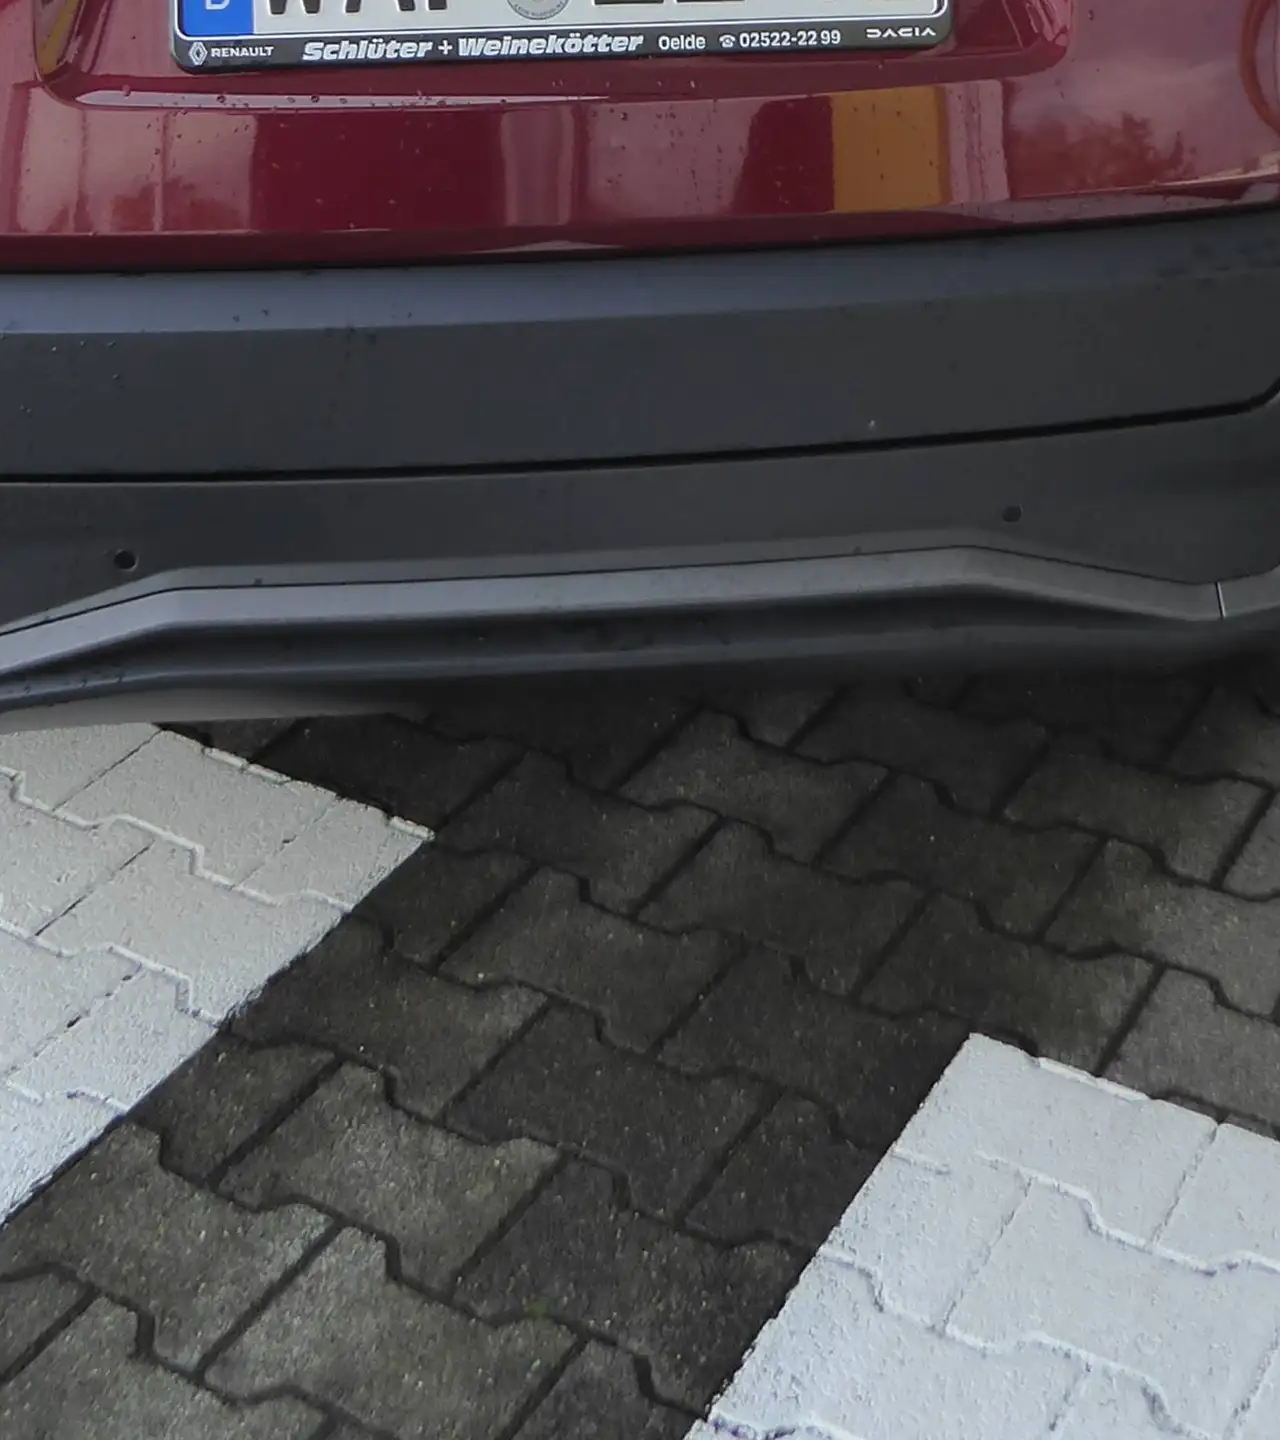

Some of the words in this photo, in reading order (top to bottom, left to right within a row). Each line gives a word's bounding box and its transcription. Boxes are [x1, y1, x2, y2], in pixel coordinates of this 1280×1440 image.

[210, 45, 275, 58] RENAULT
[303, 36, 432, 60] Schlüter
[458, 33, 644, 56] Weinekötter
[658, 33, 706, 50] Oelde
[739, 29, 819, 48] 02522-22
